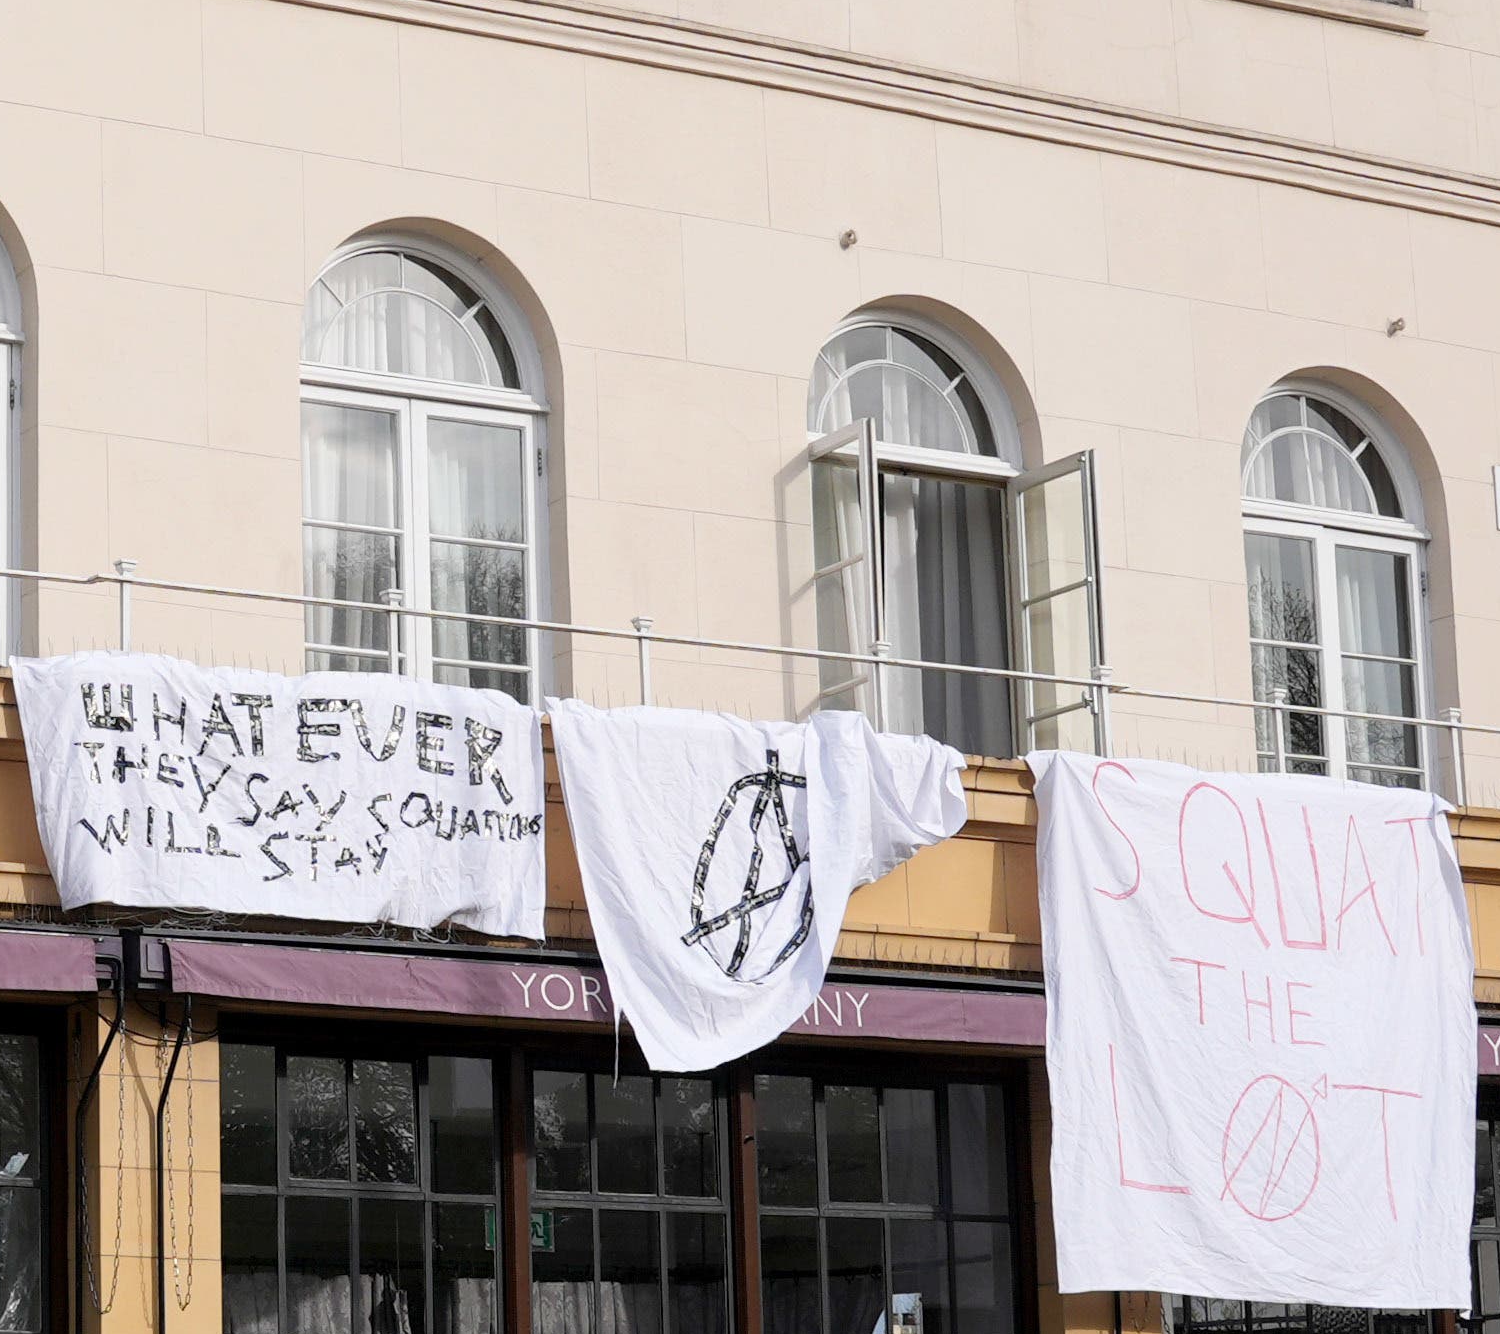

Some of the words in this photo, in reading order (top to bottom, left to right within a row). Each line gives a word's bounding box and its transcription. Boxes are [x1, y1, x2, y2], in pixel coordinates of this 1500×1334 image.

[74, 743, 232, 814] THEY
[235, 774, 347, 832] SAY
[78, 806, 241, 855] WILL
[260, 831, 389, 883] STAY
[1092, 761, 1433, 956] SQUAT
[511, 971, 608, 1013] YOR
[1169, 957, 1326, 1047] THE
